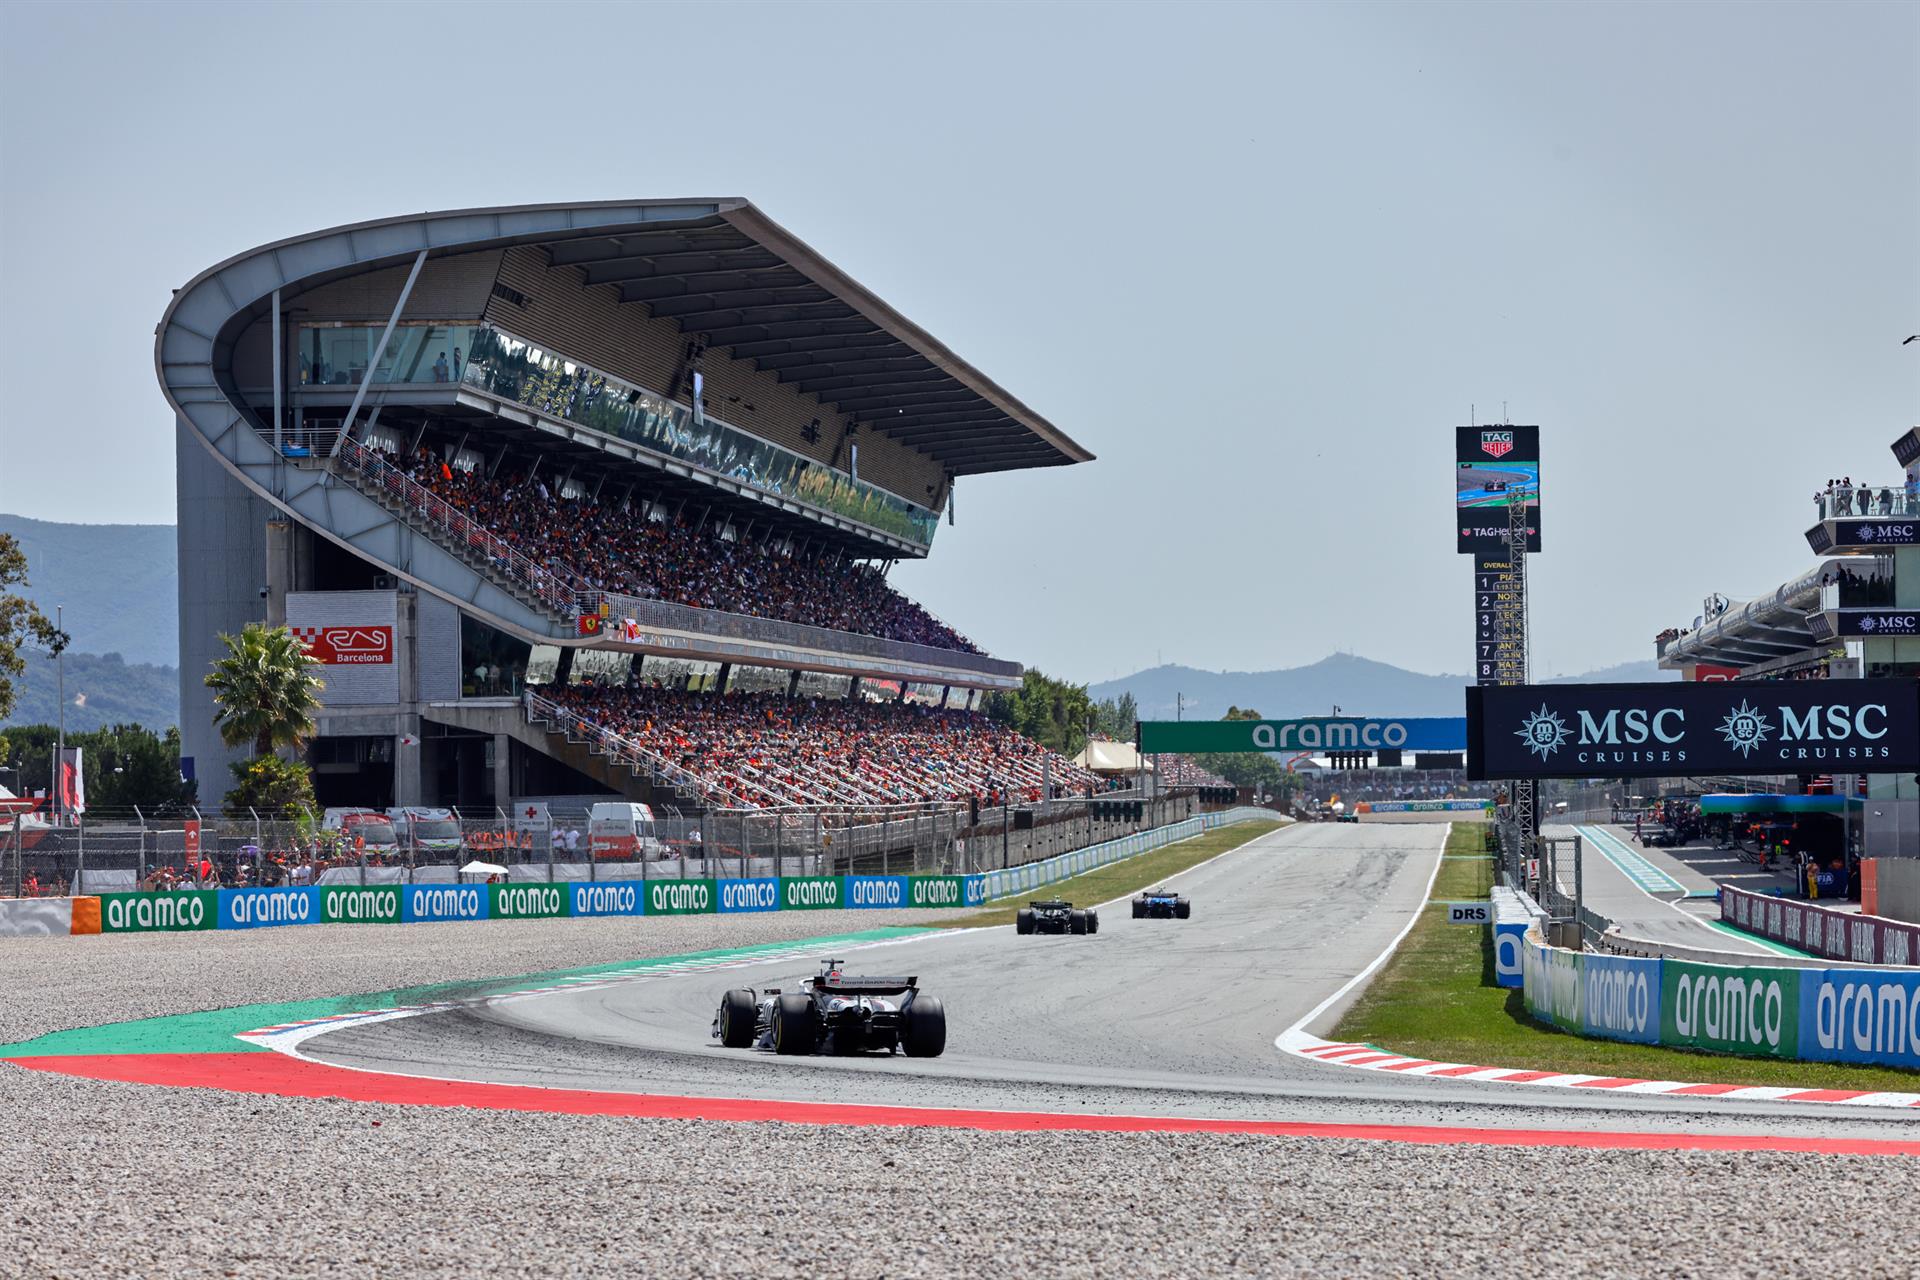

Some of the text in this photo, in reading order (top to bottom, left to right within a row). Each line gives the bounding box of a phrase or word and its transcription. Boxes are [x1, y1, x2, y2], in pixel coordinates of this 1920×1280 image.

[1485, 433, 1511, 442] TAG
[1483, 443, 1512, 456] HEUER
[1877, 525, 1913, 537] MSC
[1481, 577, 1488, 588] 1
[1481, 596, 1489, 607] 2
[1481, 615, 1489, 626] 3
[1879, 616, 1916, 628] MSC
[337, 653, 384, 663] Barcelona
[1482, 645, 1490, 656] 7
[1482, 664, 1490, 675] 8
[1577, 708, 1686, 745] MSC
[1778, 703, 1888, 741] MSC
[1252, 722, 1408, 748] aramco
[1578, 751, 1686, 763] CRUISES
[1779, 746, 1889, 759] CRUISES
[1817, 875, 1832, 883] FIA
[413, 889, 479, 917] aramco
[499, 887, 560, 914] aramco
[577, 886, 635, 913] aramco
[652, 884, 709, 910] aramco
[724, 882, 775, 907] aramco
[788, 881, 837, 905] aramco
[853, 880, 900, 904] aramco
[914, 880, 958, 903] aramco
[108, 896, 204, 928] aramco
[231, 892, 309, 922] aramco
[327, 890, 397, 919] aramco
[1453, 908, 1486, 920] DRS
[1589, 967, 1648, 1034] aramco
[1676, 972, 1782, 1047] aramco
